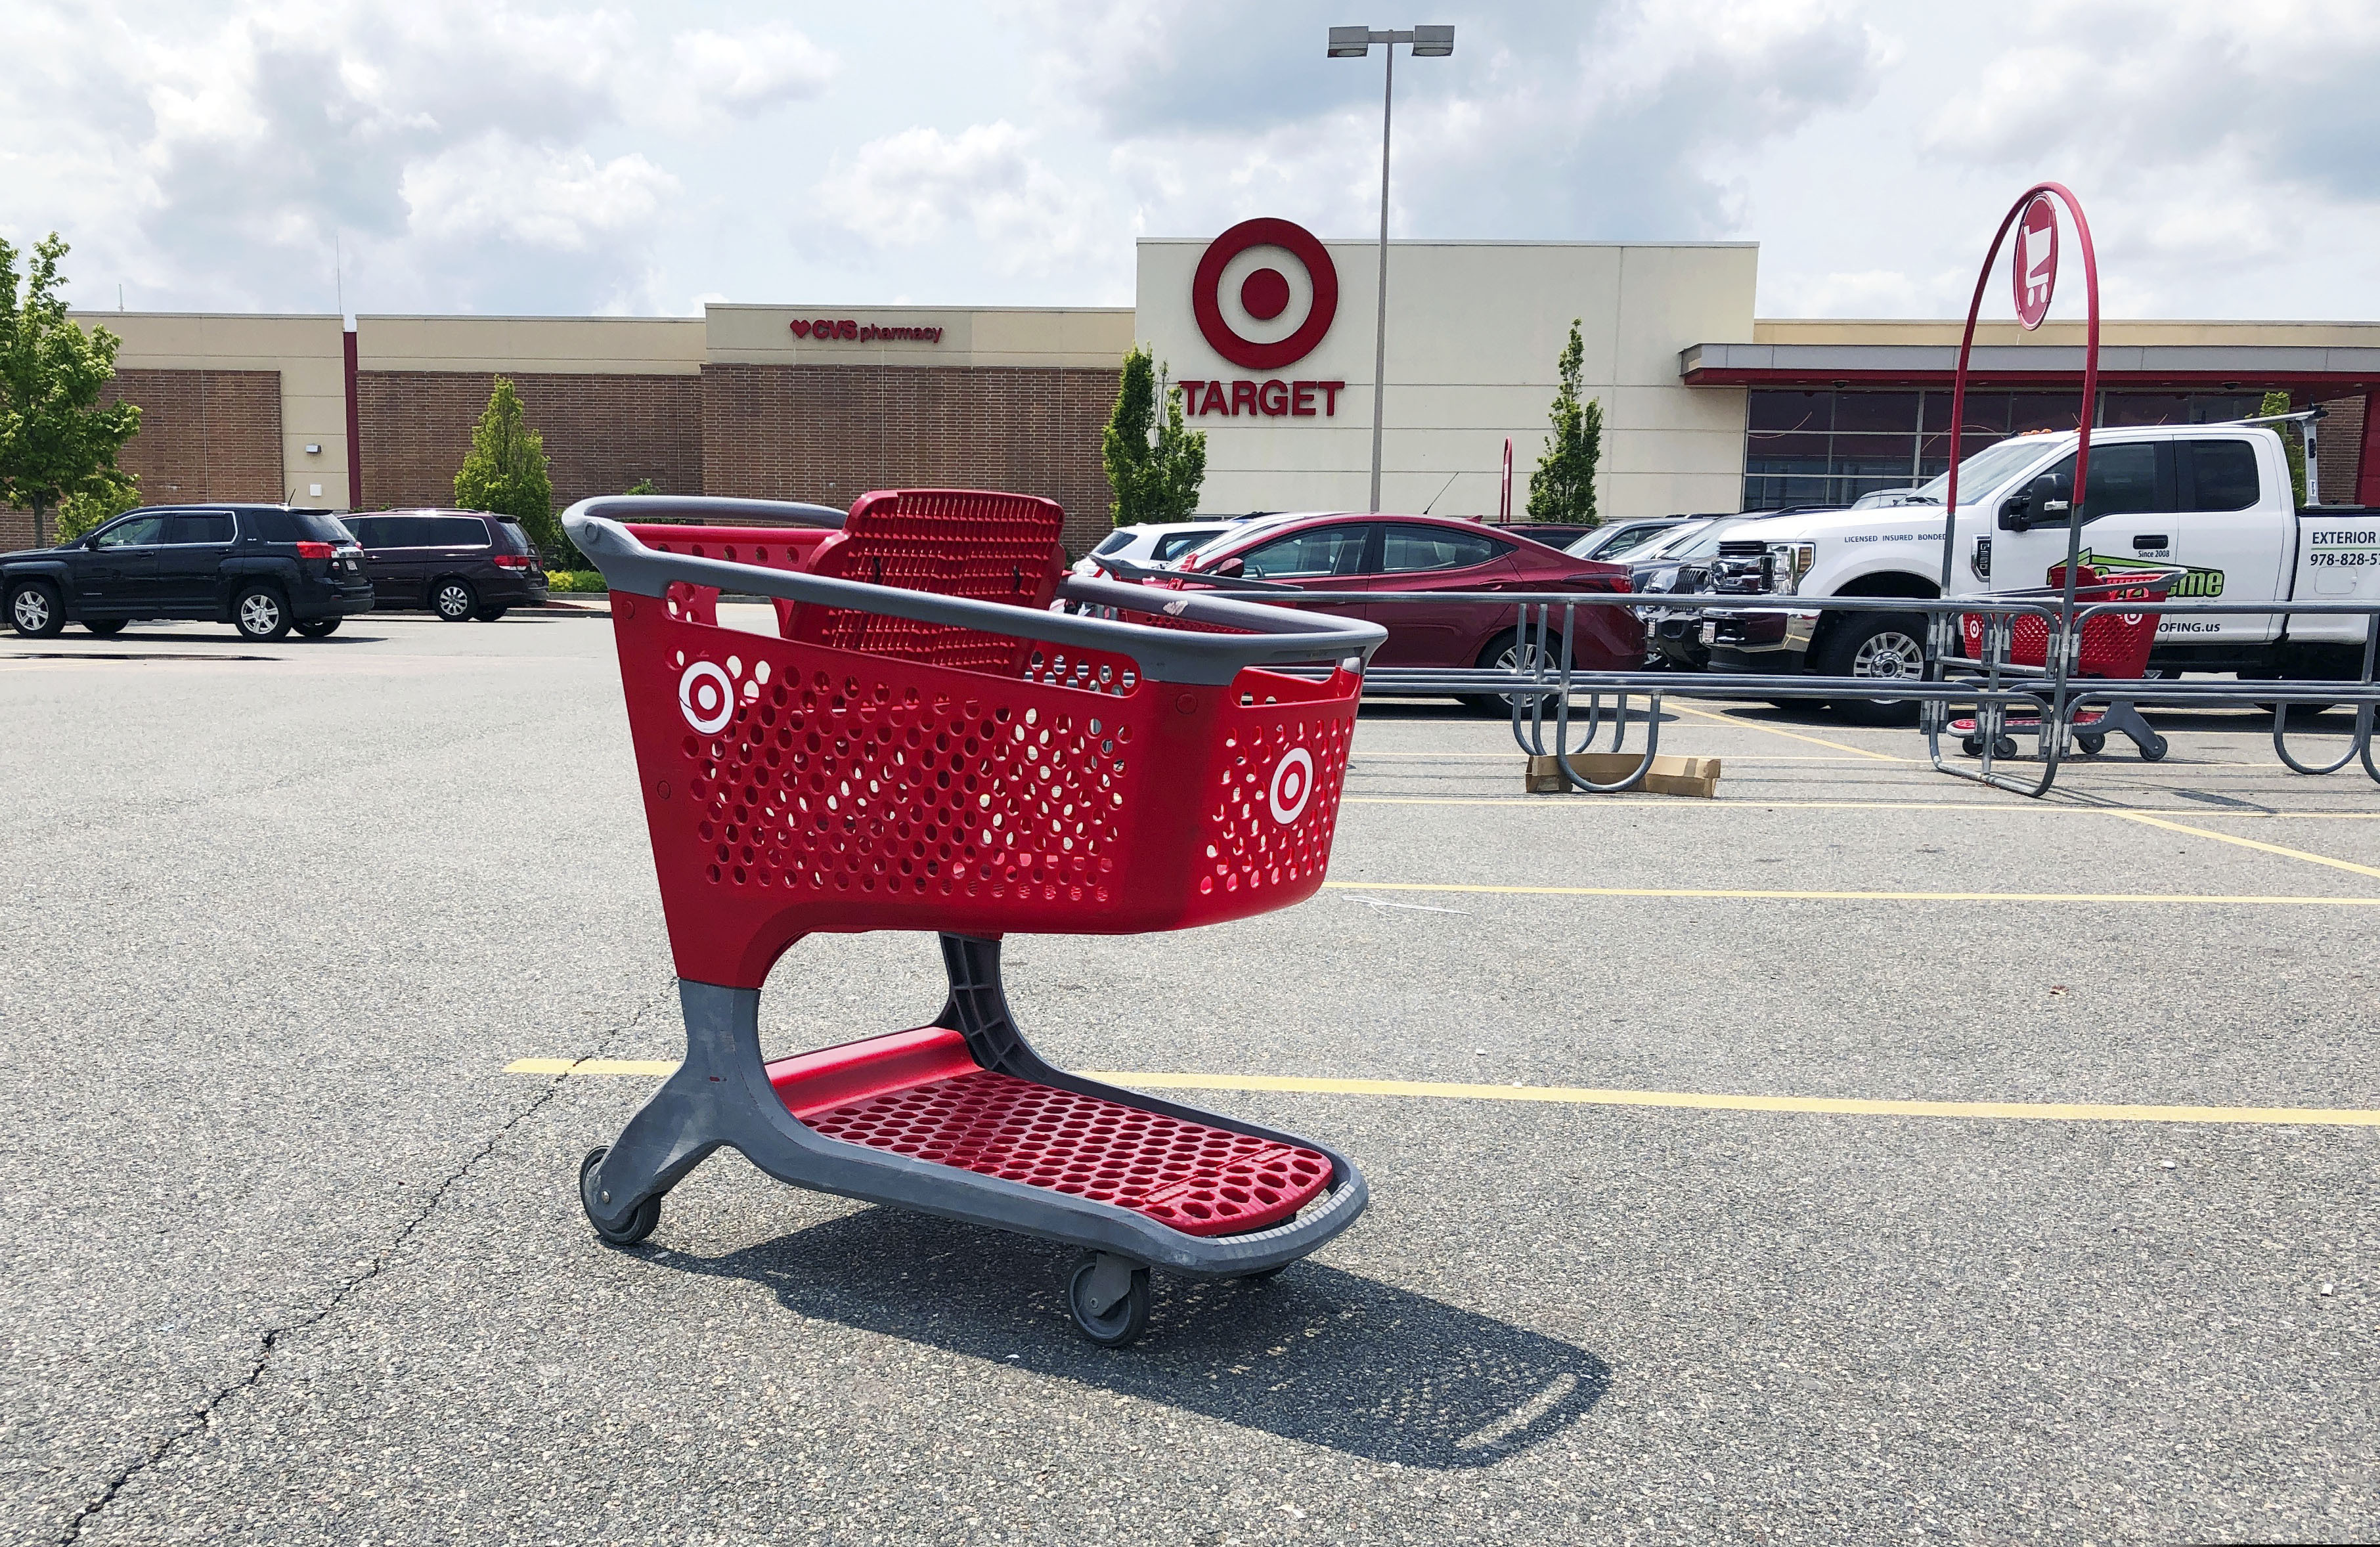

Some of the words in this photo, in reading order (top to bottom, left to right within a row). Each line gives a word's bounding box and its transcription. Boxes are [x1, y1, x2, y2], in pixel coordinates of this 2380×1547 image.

[812, 320, 858, 339] CVS
[860, 324, 942, 343] pharmacy
[1179, 379, 1345, 416] TARGET
[2312, 531, 2376, 544] EXTERIOR
[2310, 553, 2380, 566] 978-828-5
